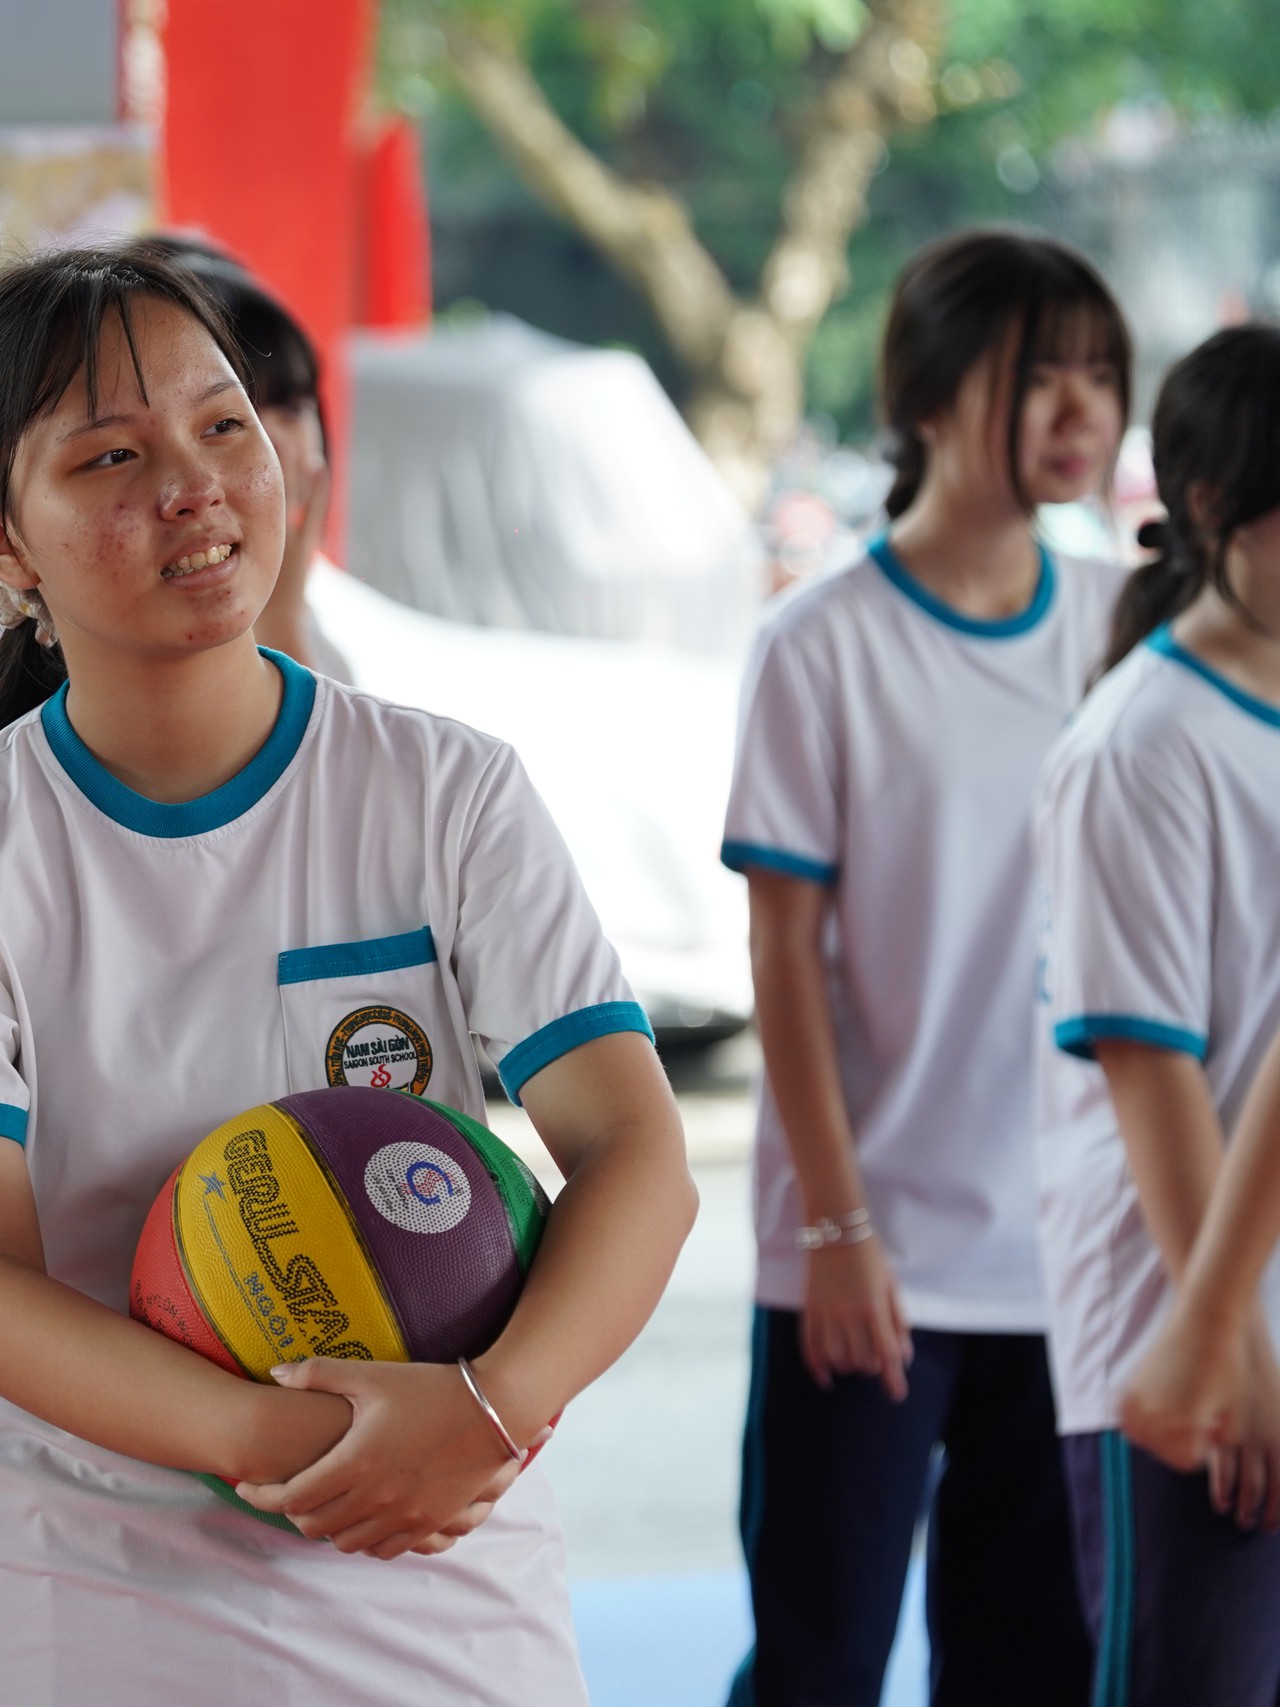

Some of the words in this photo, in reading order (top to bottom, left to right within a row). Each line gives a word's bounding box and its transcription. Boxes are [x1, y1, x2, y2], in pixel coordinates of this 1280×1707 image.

[346, 1043, 370, 1058] NAM
[371, 1037, 387, 1055] SÀI
[388, 1035, 410, 1052] GÒN
[344, 1057, 369, 1069] SAIGON
[369, 1054, 390, 1067] SOUTH
[391, 1051, 418, 1063] SCHOOL
